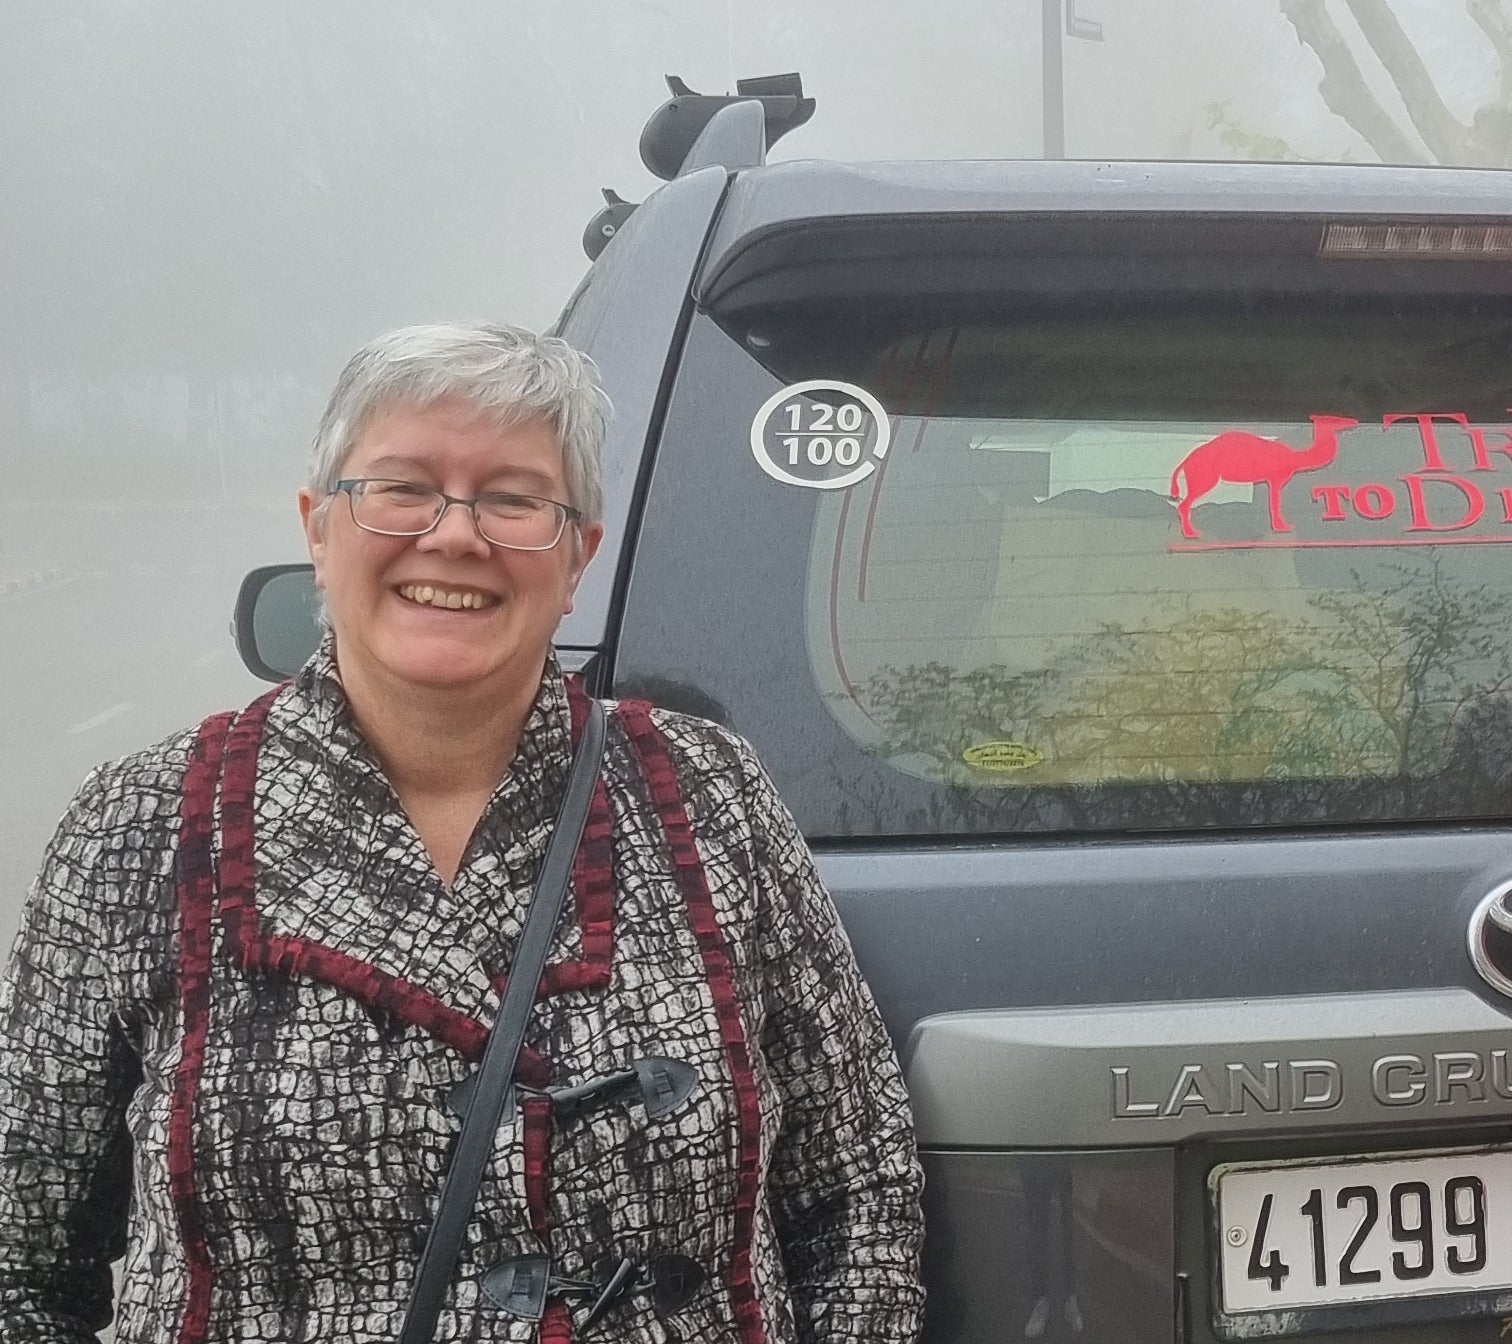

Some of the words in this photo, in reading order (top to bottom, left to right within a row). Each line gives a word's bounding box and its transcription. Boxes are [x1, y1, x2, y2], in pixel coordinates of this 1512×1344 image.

[785, 403, 862, 432] 120
[782, 437, 861, 466] 100
[1311, 483, 1397, 522] TO
[1108, 1056, 1346, 1120] LAND
[1246, 1174, 1490, 1293] 41299
